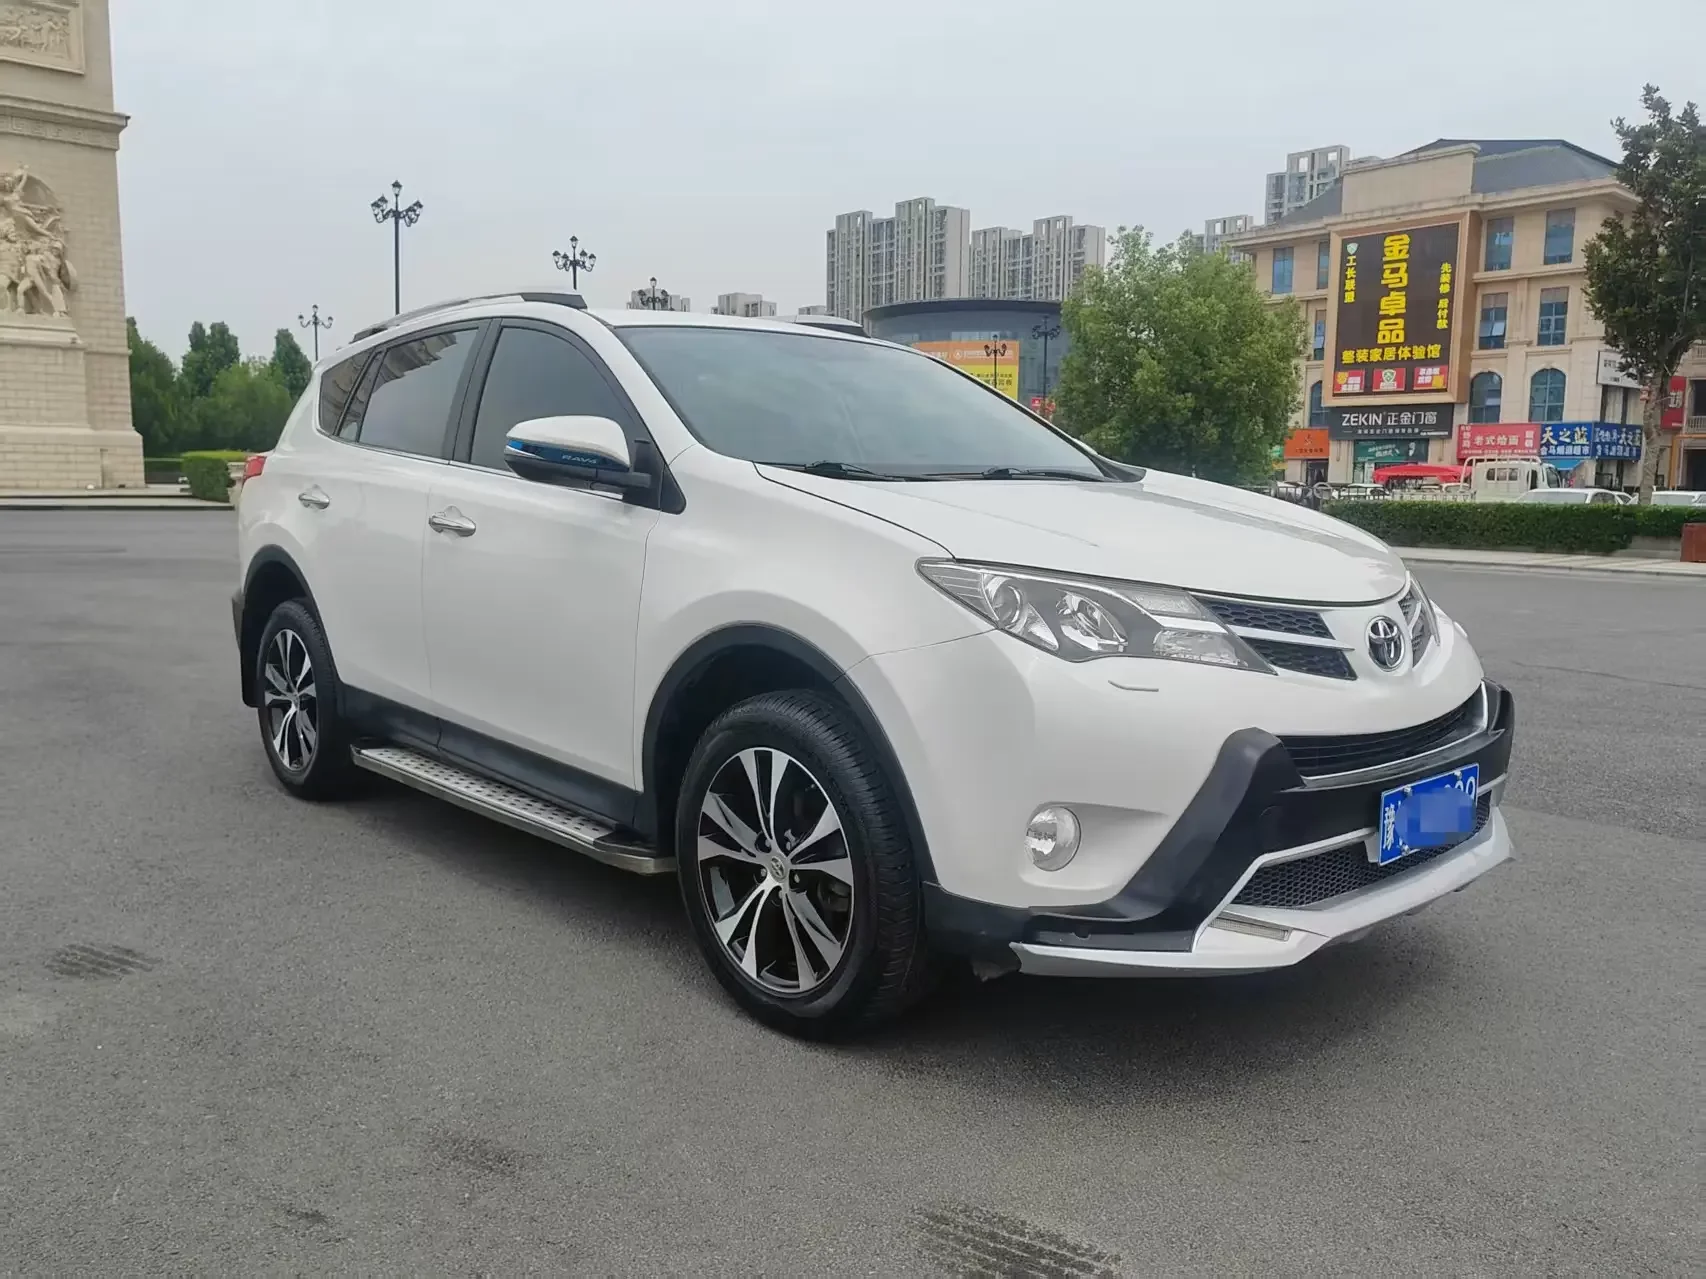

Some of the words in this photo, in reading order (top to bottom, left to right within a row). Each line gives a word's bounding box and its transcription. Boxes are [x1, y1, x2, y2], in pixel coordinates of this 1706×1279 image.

[1377, 233, 1410, 344] 金马卓品
[1342, 413, 1382, 426] ZEKIN
[1387, 411, 1437, 425] 正金门窗
[1540, 426, 1589, 445] 天之蓝
[562, 454, 597, 464] RAV4
